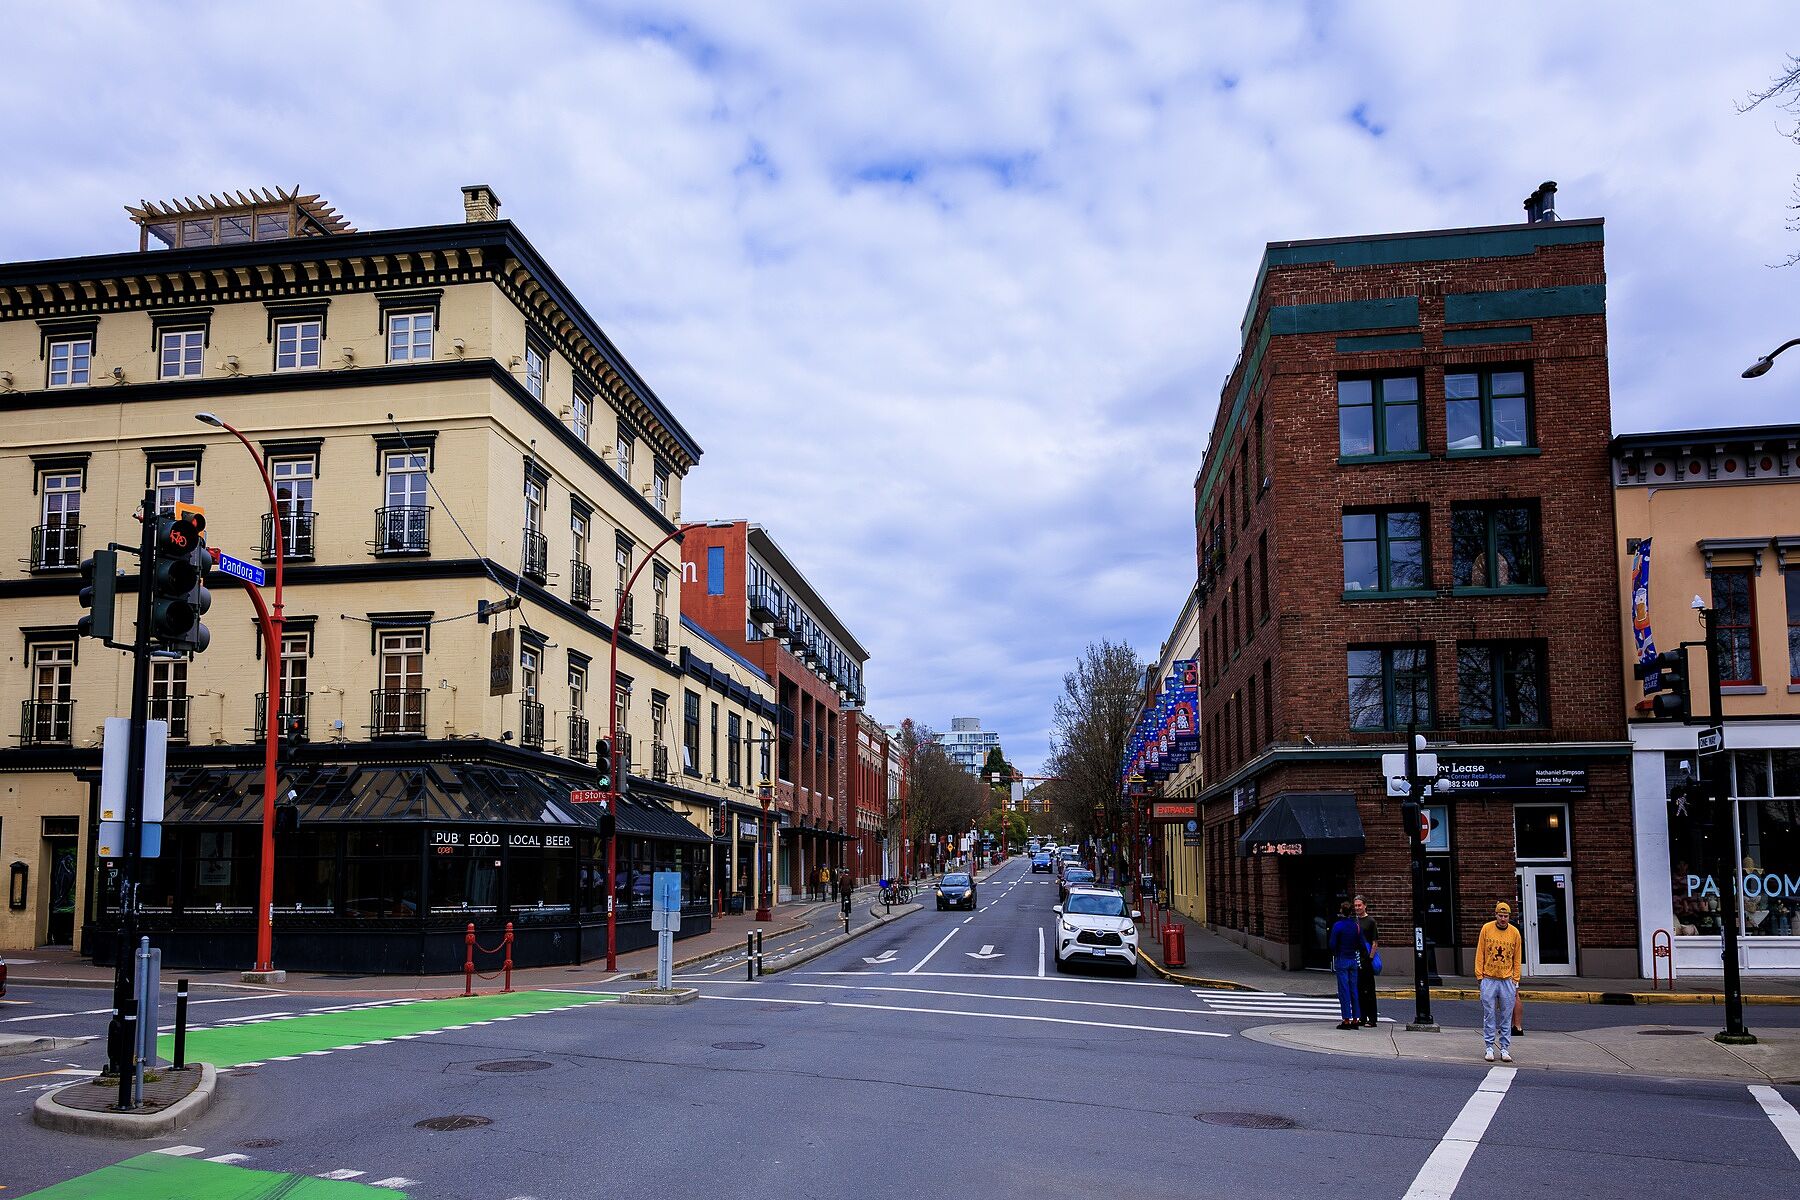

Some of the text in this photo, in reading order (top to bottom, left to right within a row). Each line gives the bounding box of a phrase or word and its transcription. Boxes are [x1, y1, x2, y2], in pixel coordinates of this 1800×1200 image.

[222, 556, 253, 579] Pandora
[1451, 762, 1485, 773] Lease
[1561, 769, 1585, 777] Simpson
[1461, 780, 1479, 788] 3400
[1157, 806, 1195, 814] ENTRANCE
[436, 832, 571, 846] PUB FOOD LOCAL BEER
